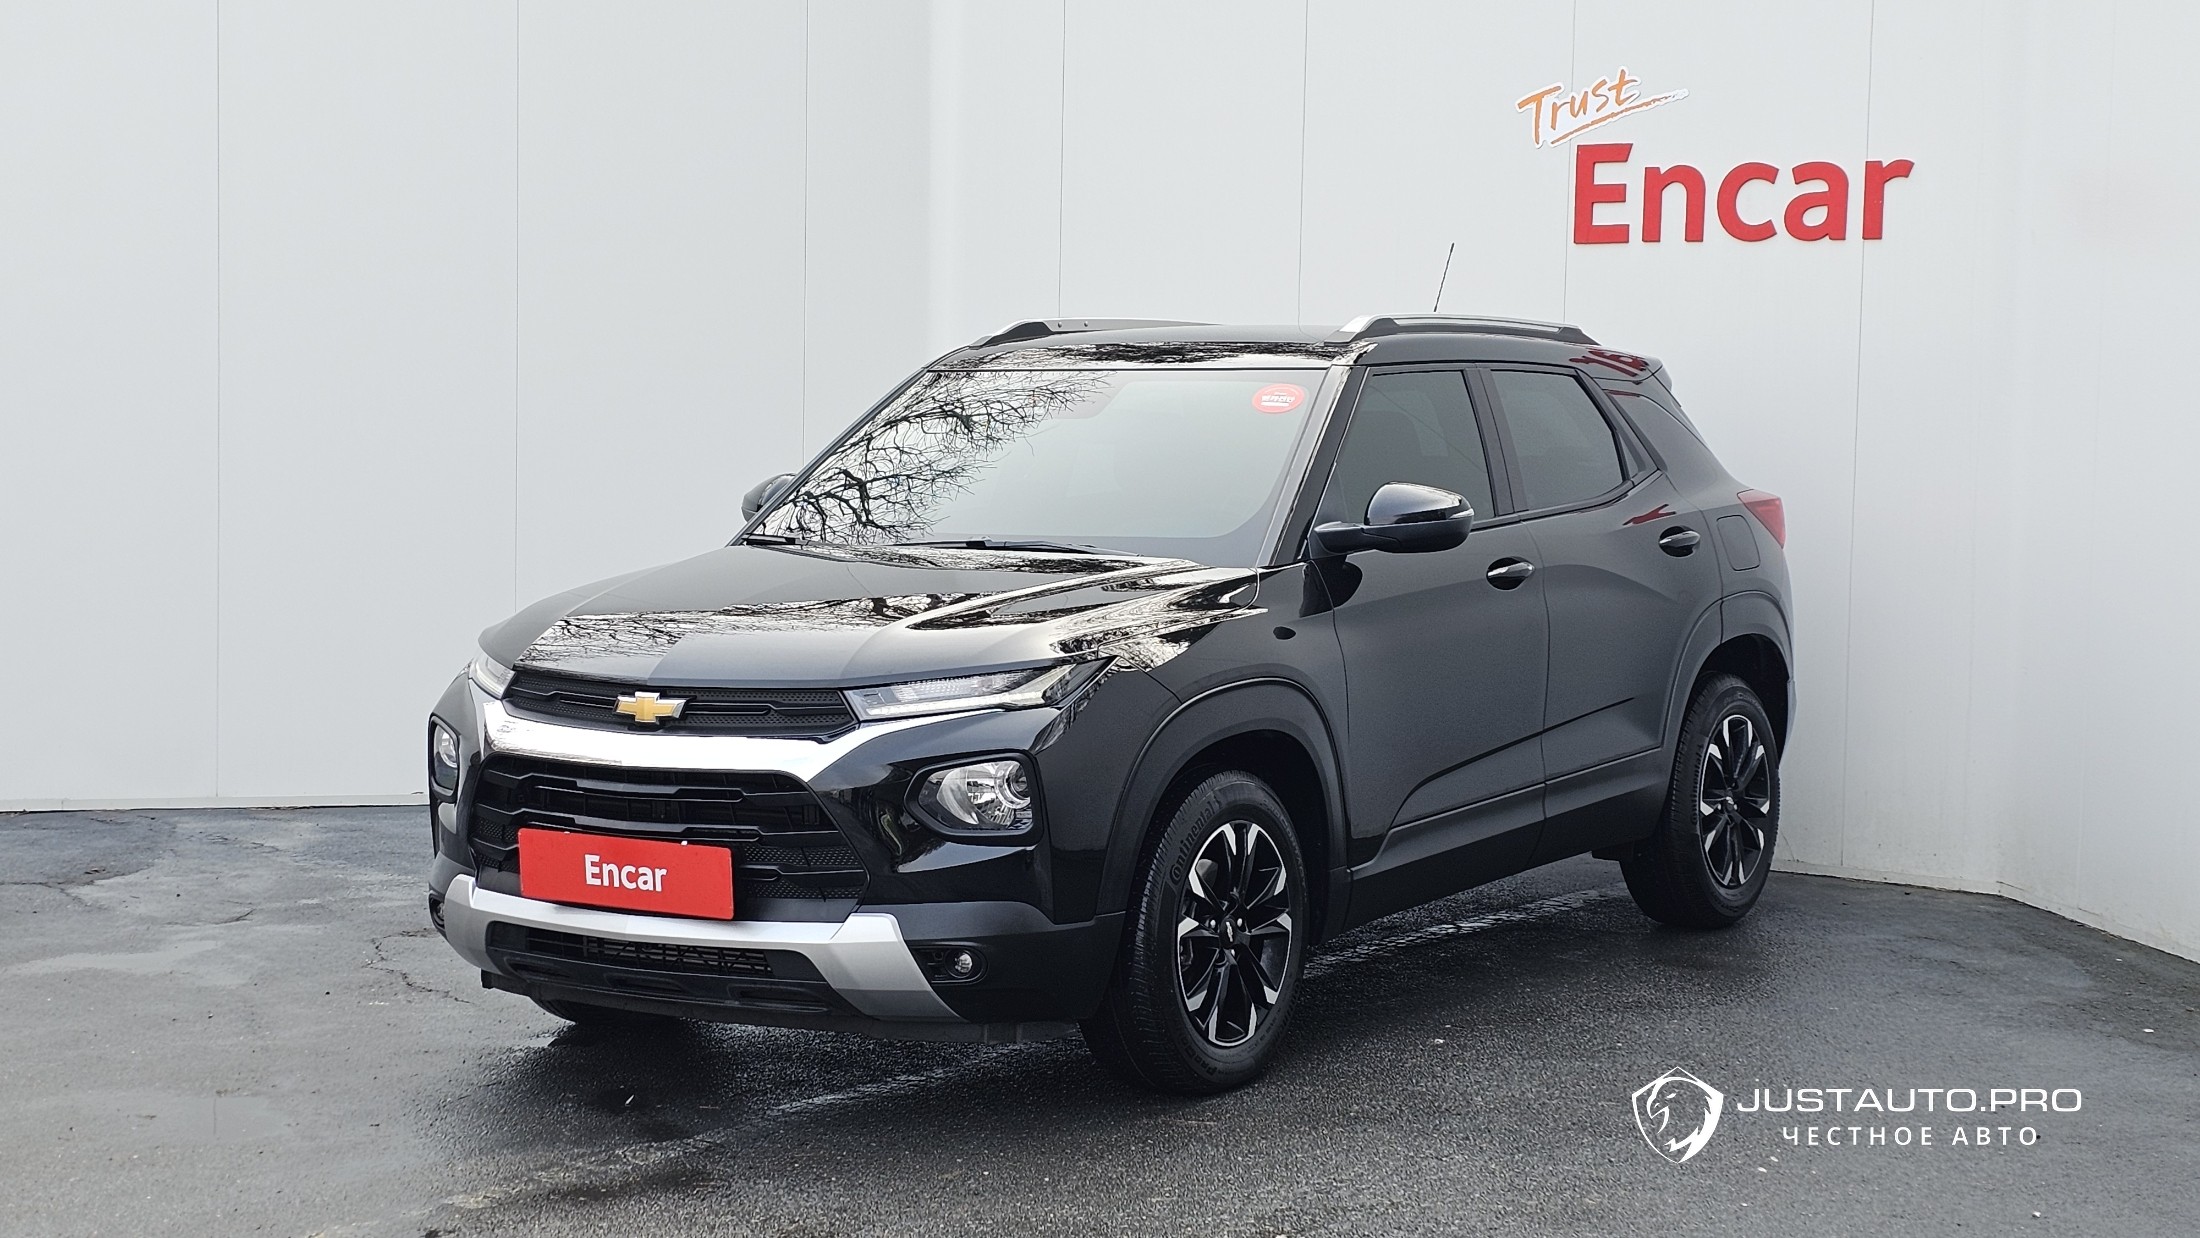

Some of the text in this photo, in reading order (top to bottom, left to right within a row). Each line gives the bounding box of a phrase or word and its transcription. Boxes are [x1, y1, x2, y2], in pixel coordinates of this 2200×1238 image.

[1517, 69, 1640, 145] Trust
[1573, 142, 1914, 245] Encar
[584, 853, 667, 893] Encar
[1169, 800, 1217, 886] Continental
